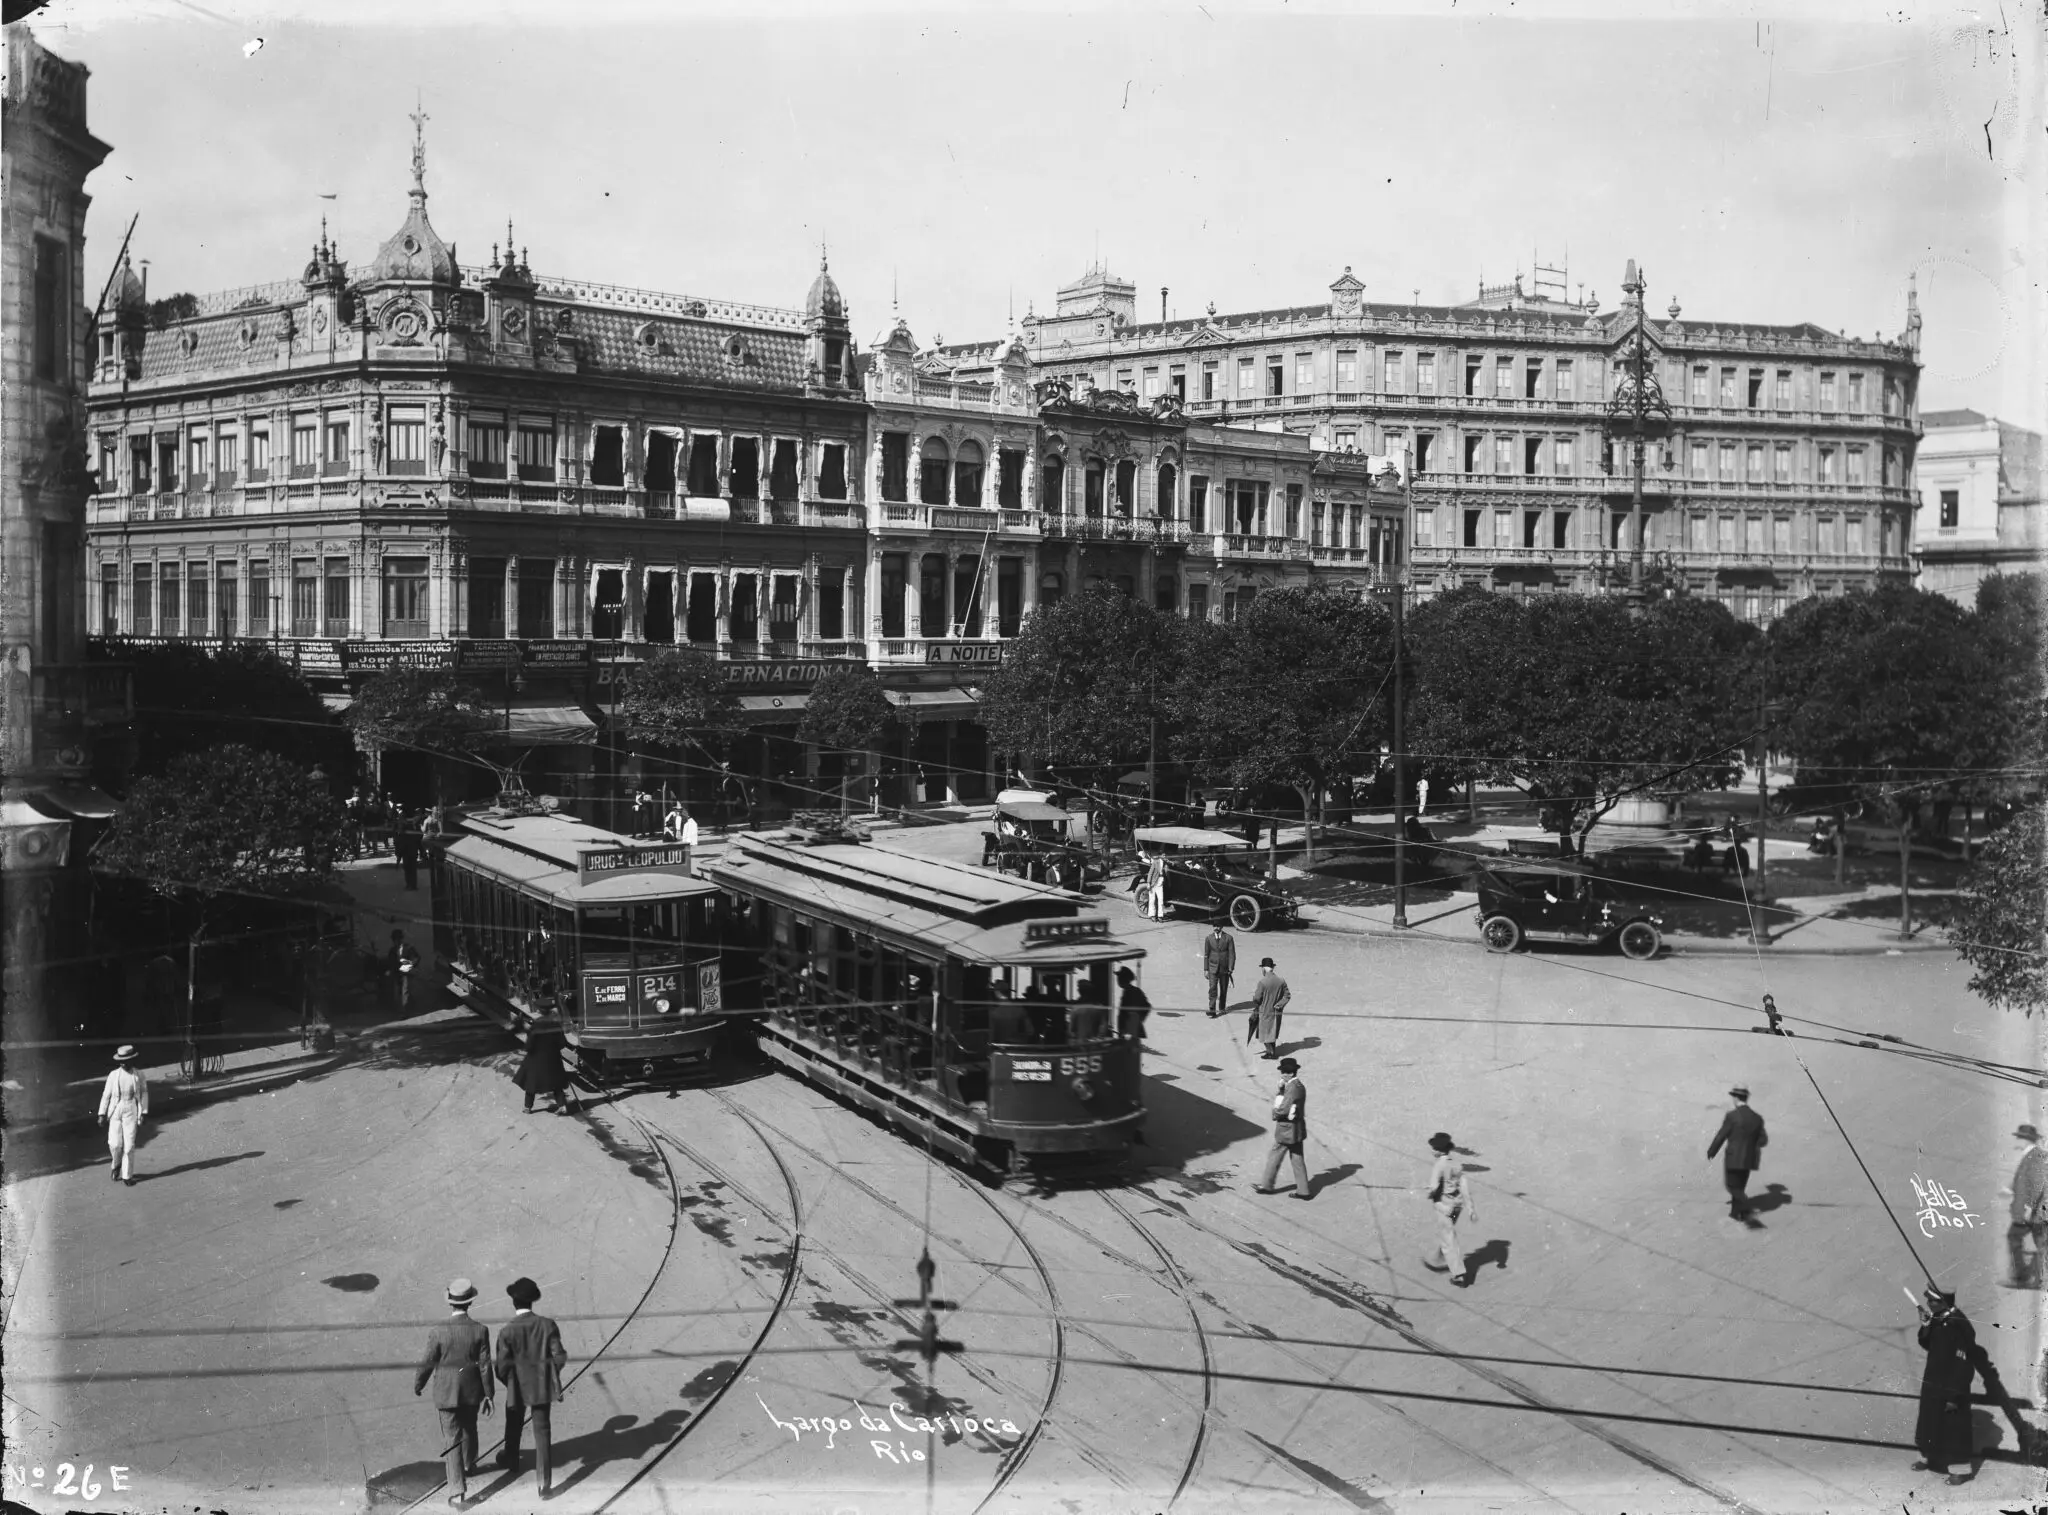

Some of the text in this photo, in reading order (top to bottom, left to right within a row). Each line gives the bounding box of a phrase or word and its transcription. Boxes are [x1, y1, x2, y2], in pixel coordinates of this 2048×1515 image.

[347, 643, 391, 653] TERRENOS
[400, 641, 451, 655] PRESTAÇÕES
[930, 644, 998, 661] A NOITE
[606, 985, 626, 994] FERRO
[644, 976, 676, 993] 214
[1059, 1055, 1103, 1075] 555
